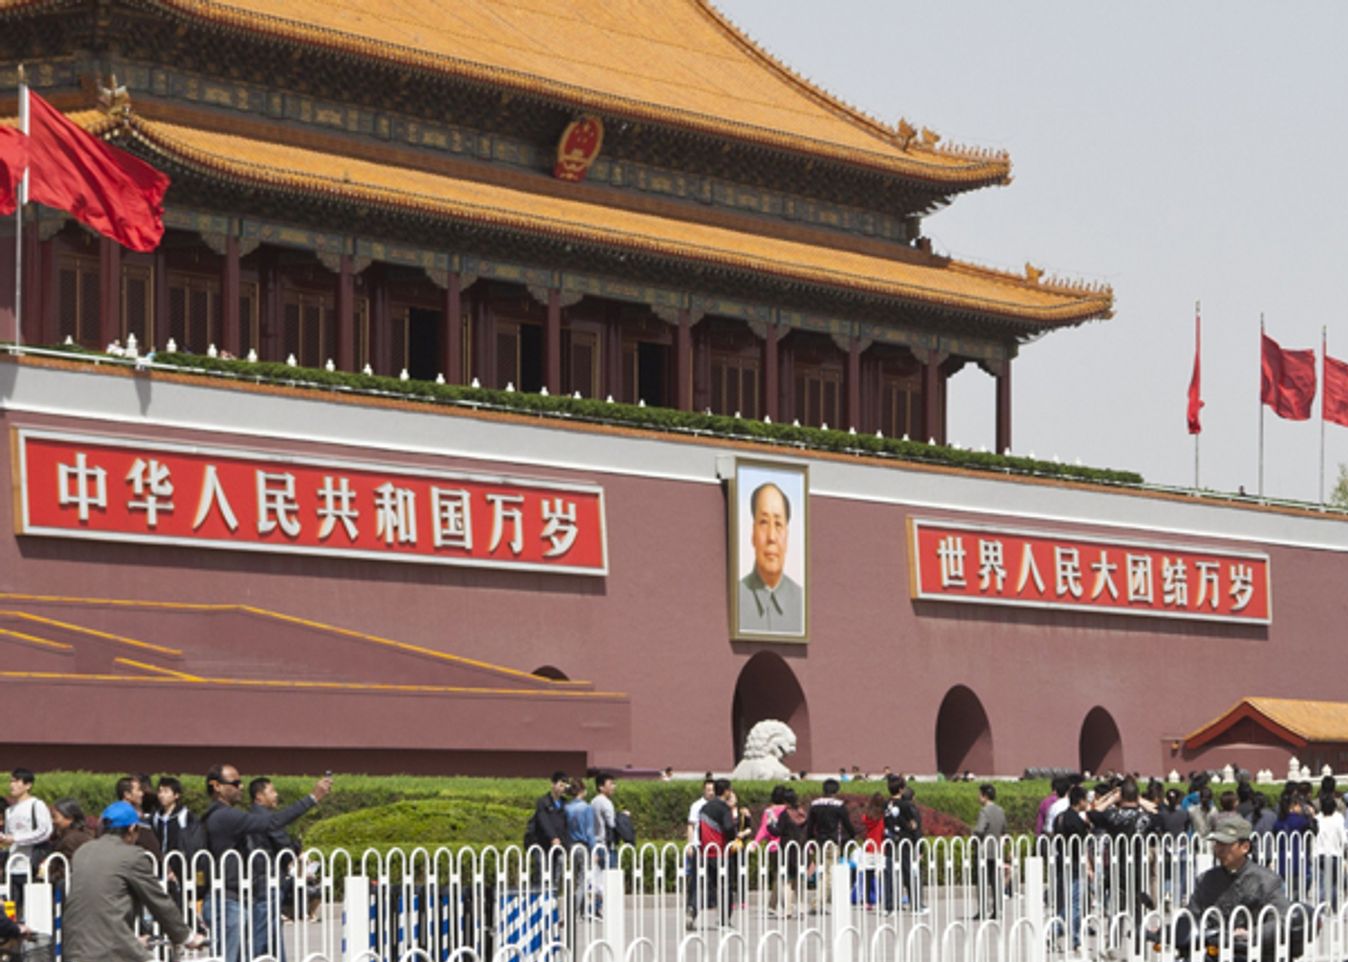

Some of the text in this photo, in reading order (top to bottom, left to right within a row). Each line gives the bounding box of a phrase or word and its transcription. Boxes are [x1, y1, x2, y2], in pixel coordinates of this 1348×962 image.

[57, 453, 580, 557] 中华人民共和国万岁
[937, 535, 1255, 612] 世界人民大团结万岁
